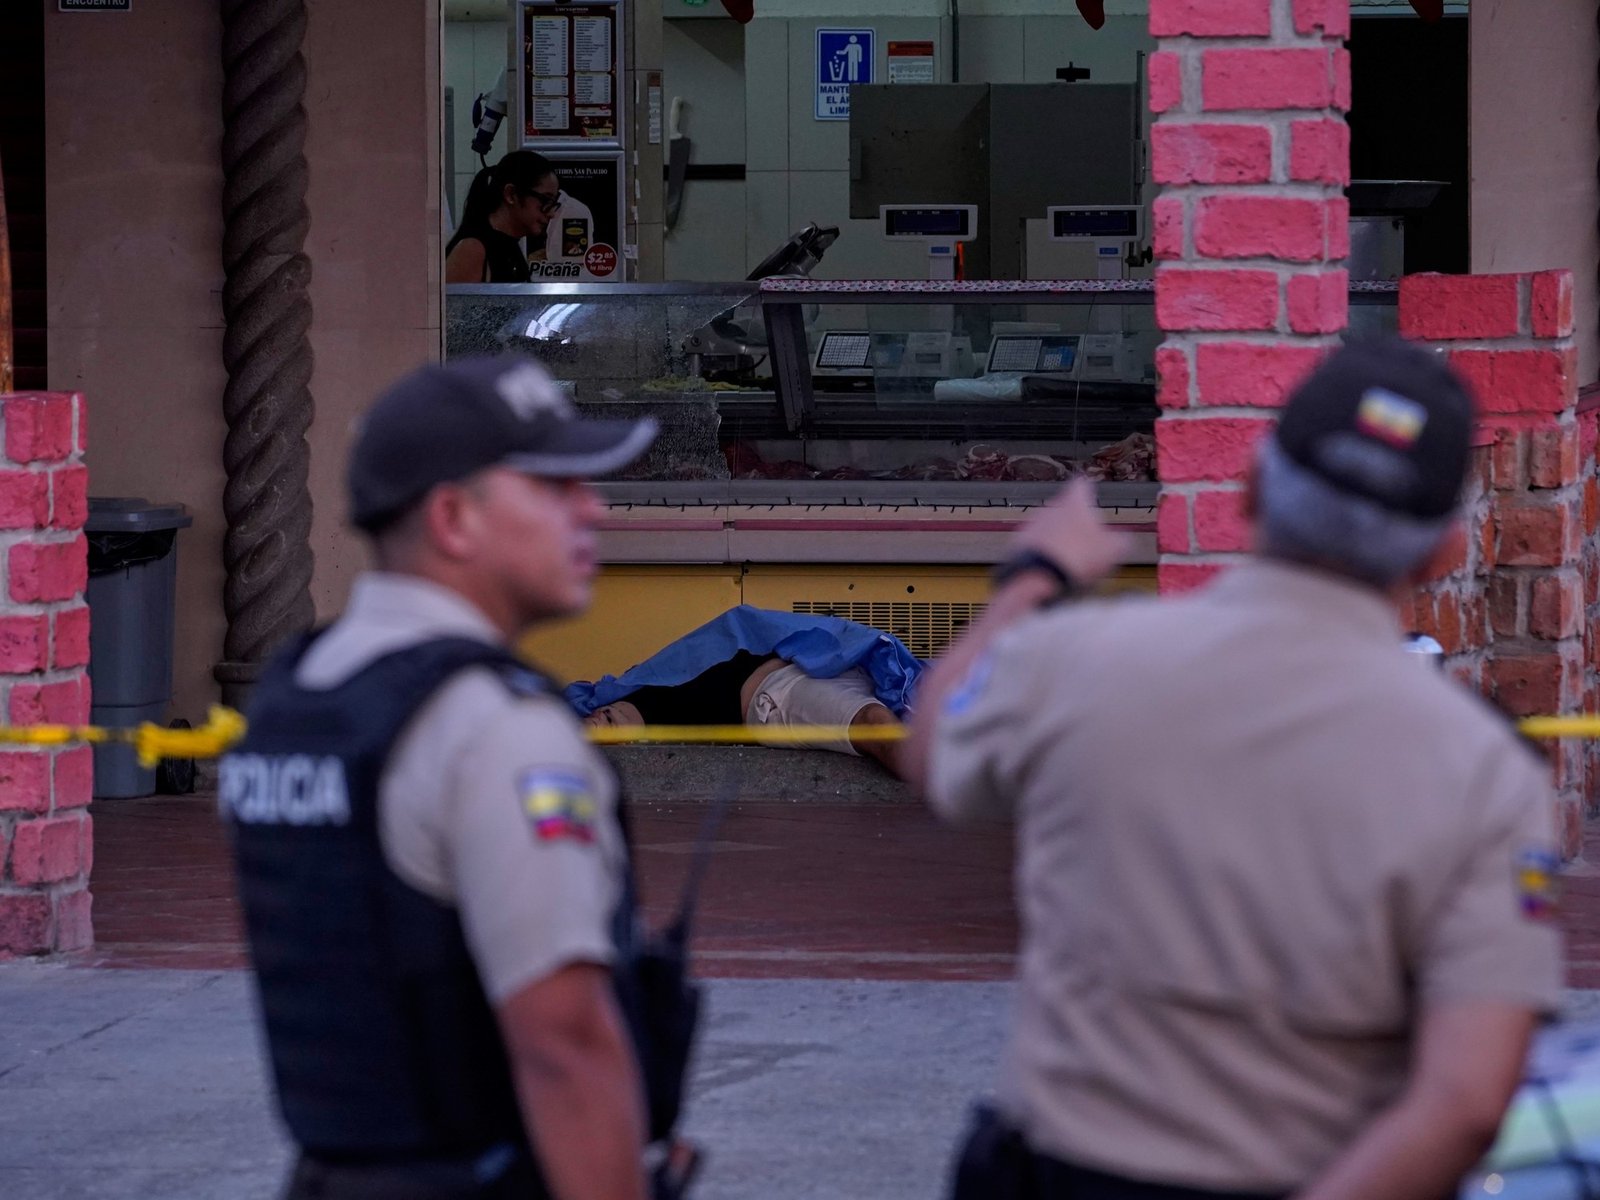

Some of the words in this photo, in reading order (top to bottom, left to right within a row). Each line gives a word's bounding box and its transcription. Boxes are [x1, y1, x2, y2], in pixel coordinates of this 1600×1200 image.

[826, 96, 837, 104] EL
[529, 261, 581, 277] Picaña
[217, 752, 351, 826] POLICIA
